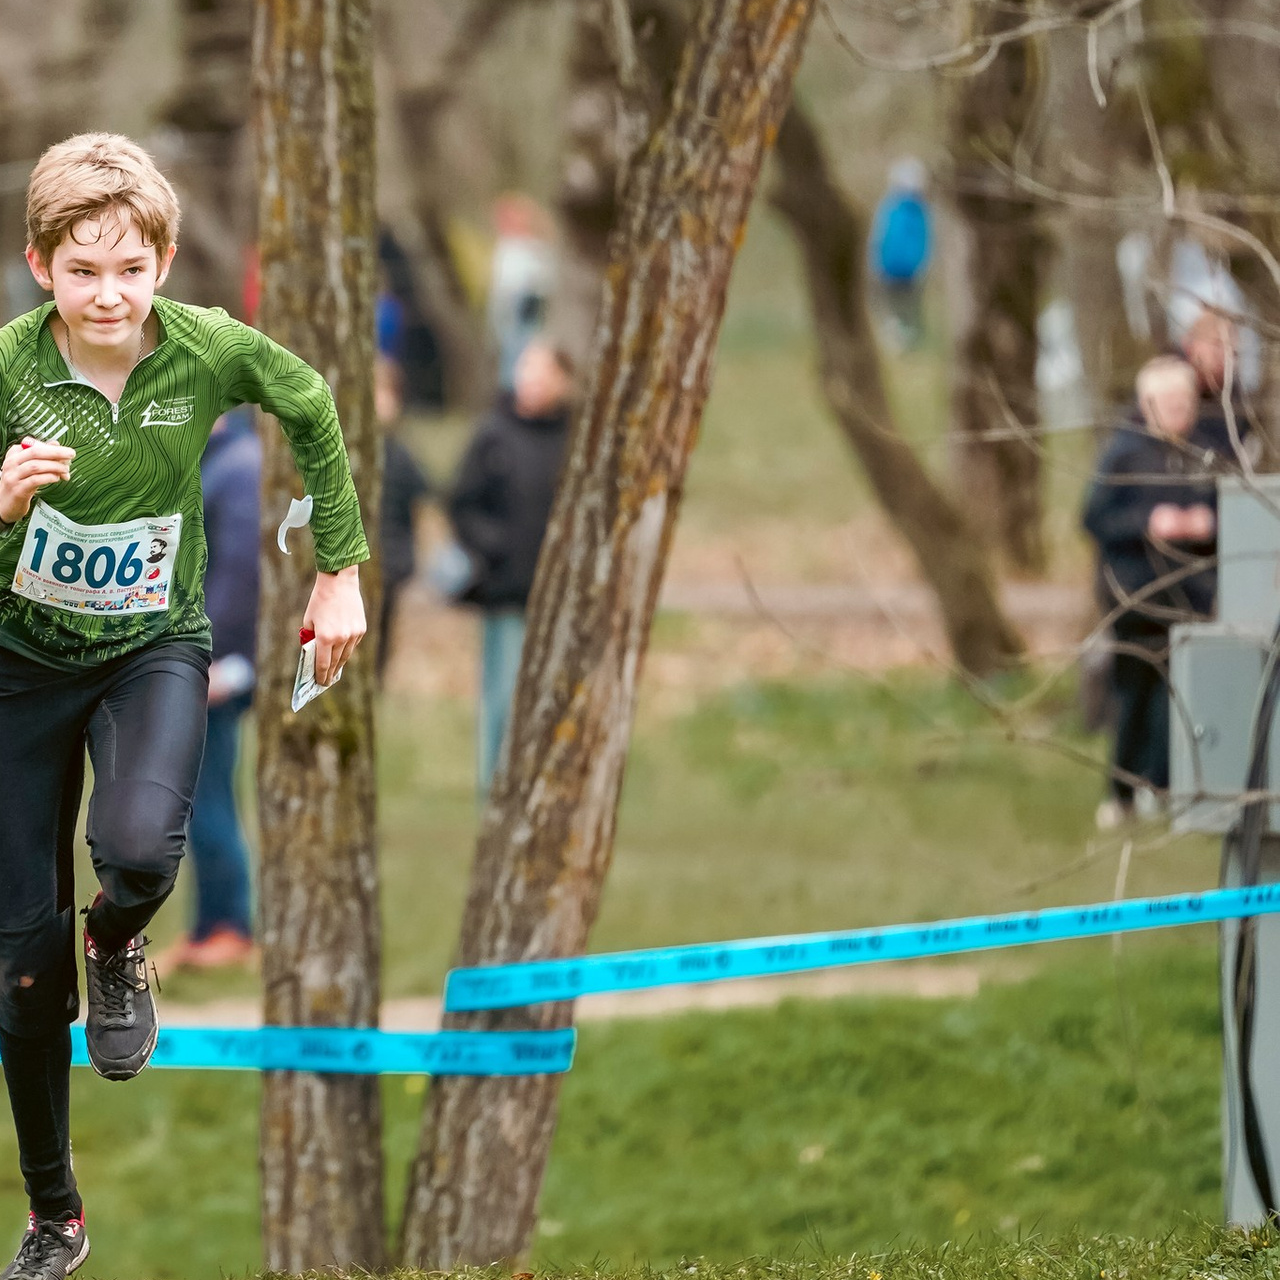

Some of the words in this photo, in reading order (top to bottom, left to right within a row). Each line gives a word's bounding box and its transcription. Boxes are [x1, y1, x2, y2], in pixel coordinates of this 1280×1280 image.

[152, 405, 194, 416] FOREST
[167, 413, 190, 421] TEAM
[30, 527, 144, 589] 1806
